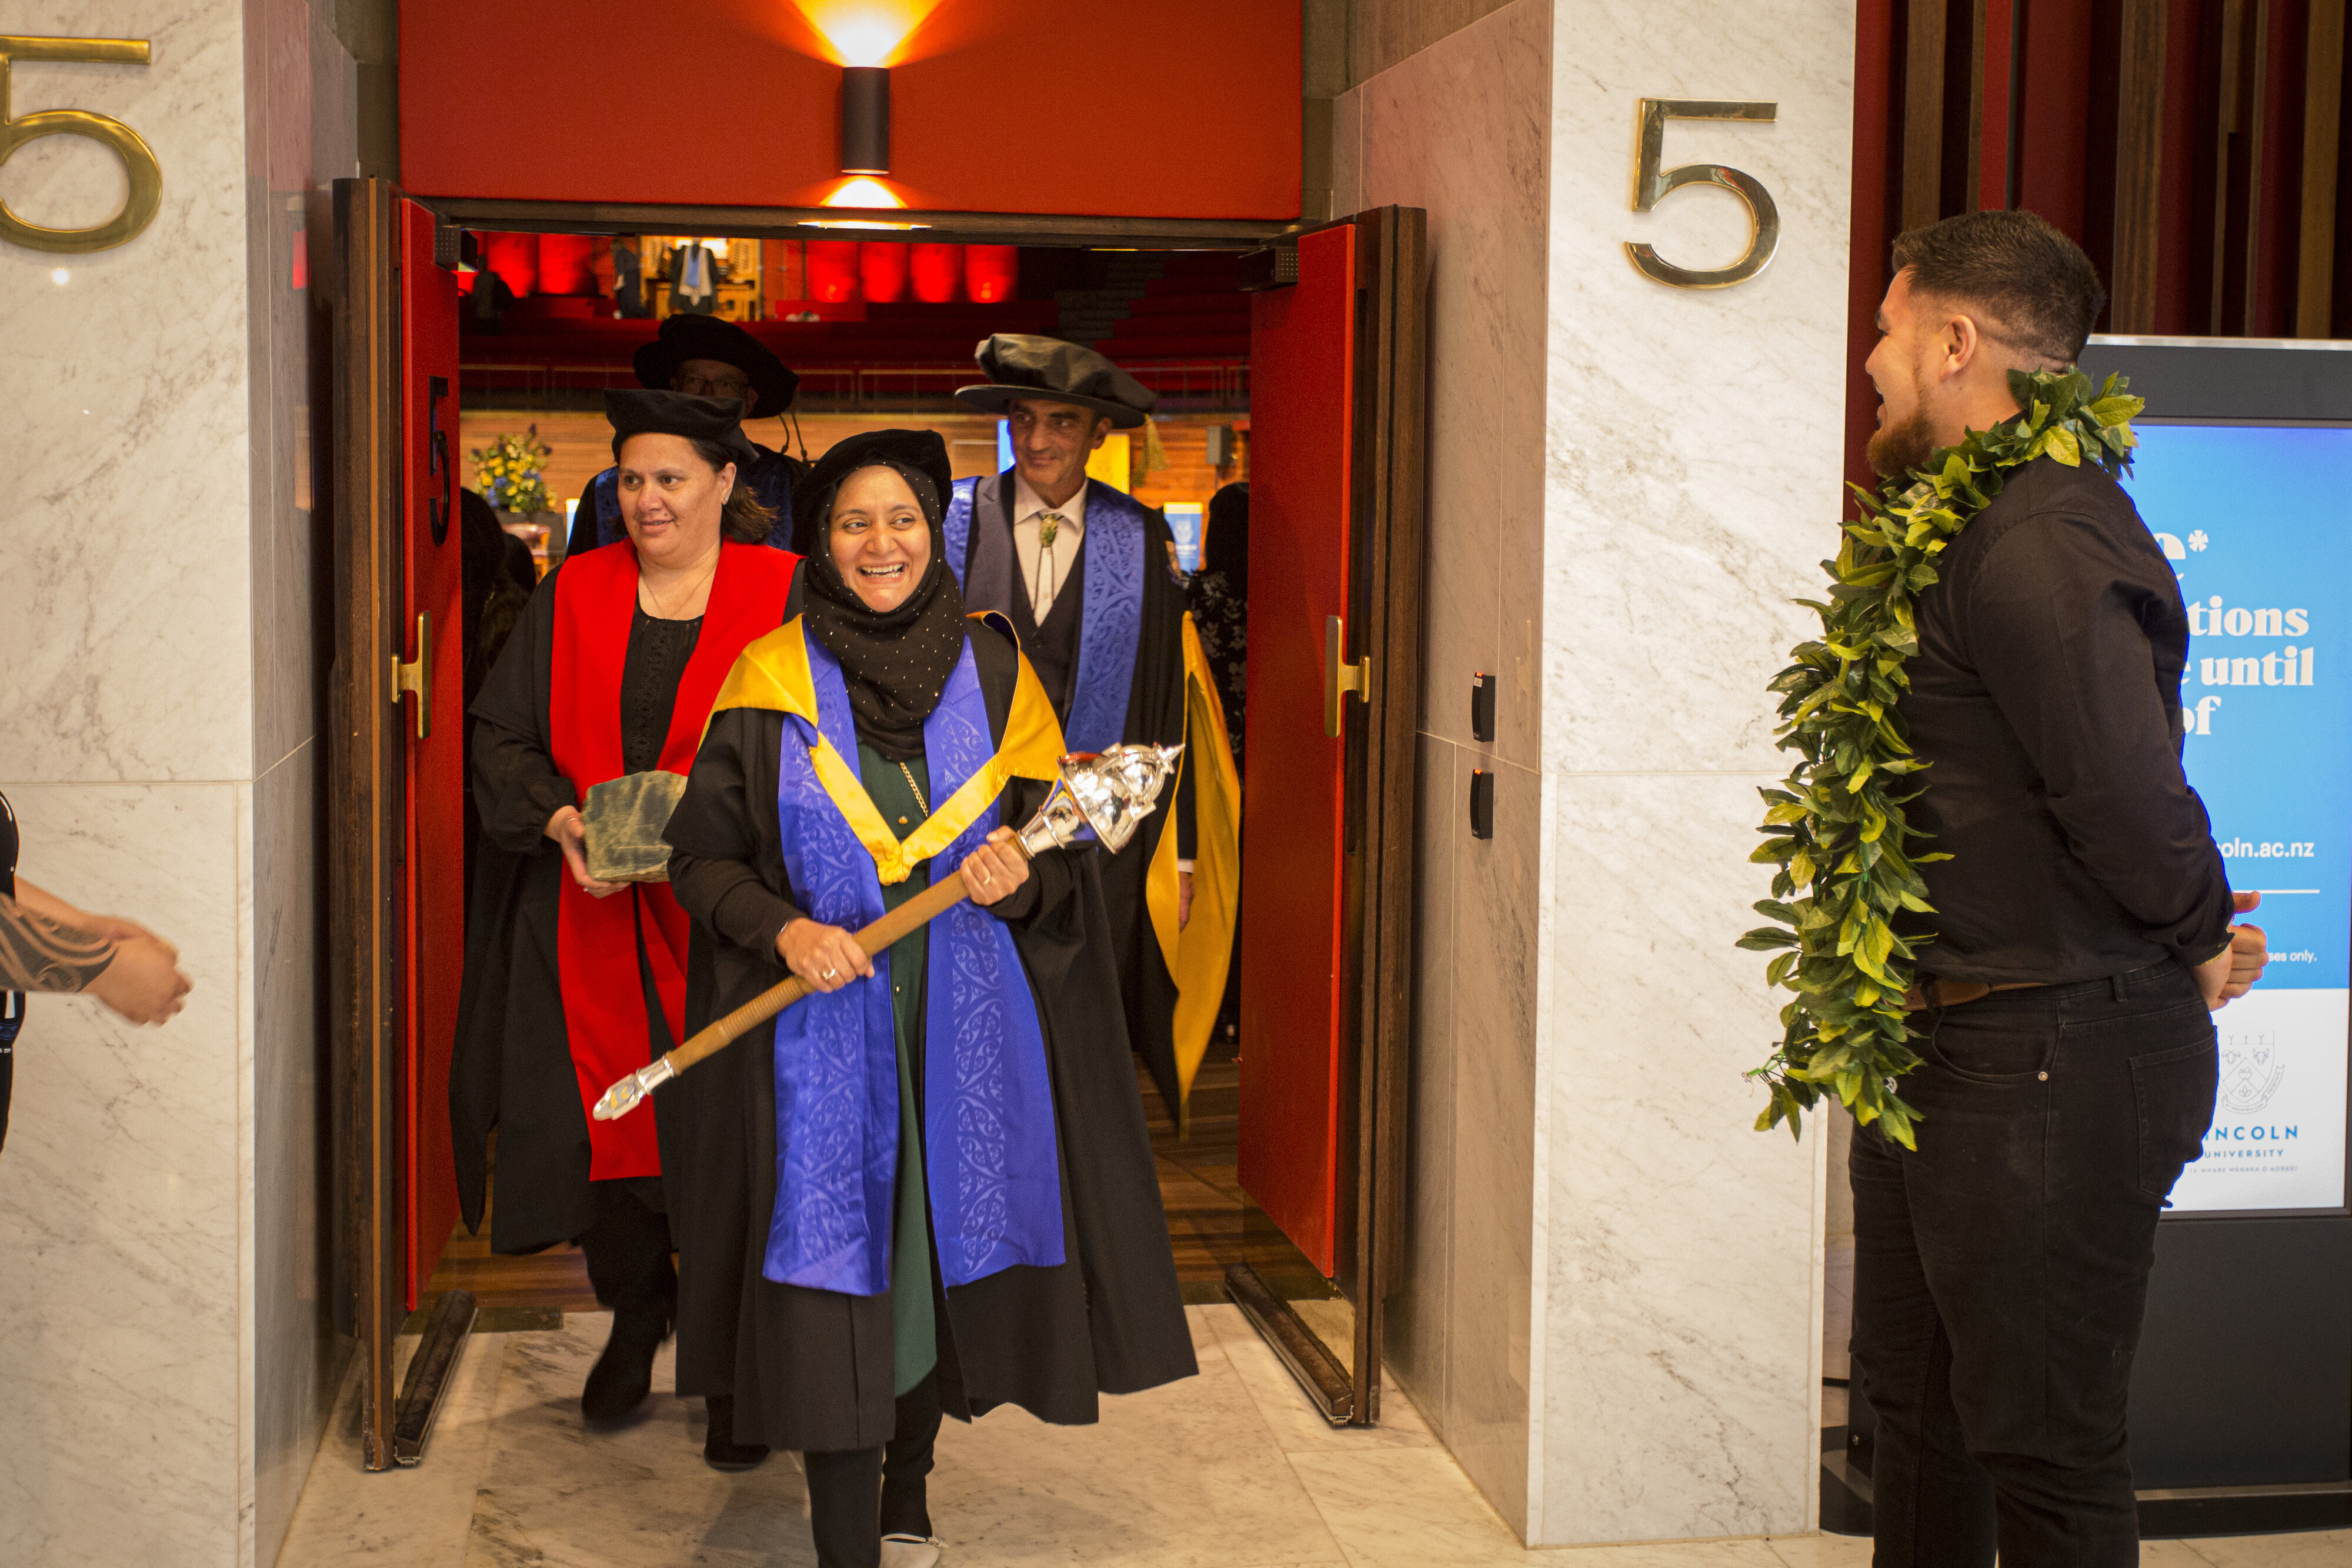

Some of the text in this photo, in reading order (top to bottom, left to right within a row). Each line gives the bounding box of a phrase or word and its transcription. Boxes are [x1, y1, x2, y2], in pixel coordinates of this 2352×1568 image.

[1624, 98, 1780, 291] 5
[428, 375, 451, 548] 5
[2200, 646, 2314, 686] until
[2217, 837, 2315, 858] oln.ac.nz
[2290, 949, 2318, 964] only.
[2204, 1149, 2284, 1158] UNIVERSITY
